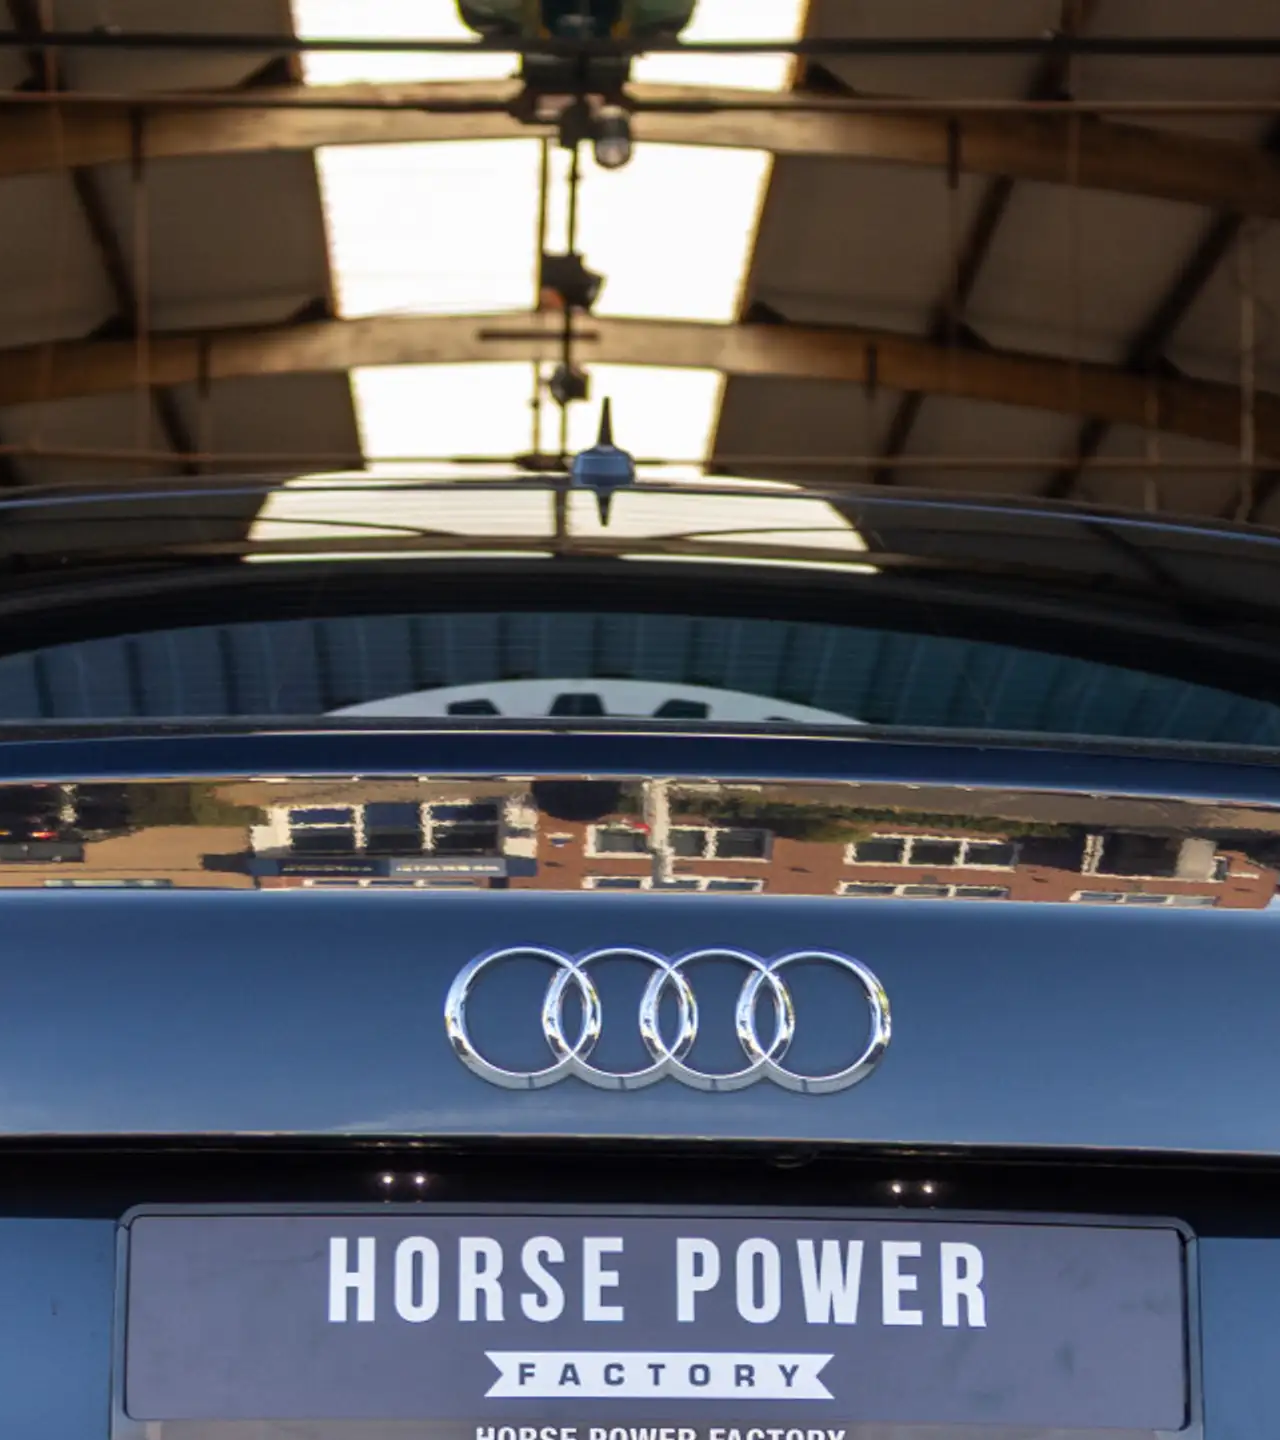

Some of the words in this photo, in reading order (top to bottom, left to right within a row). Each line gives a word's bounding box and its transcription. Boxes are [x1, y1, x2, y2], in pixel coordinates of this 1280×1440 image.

[327, 1235, 625, 1323] HORSE
[675, 1237, 988, 1328] POWER
[517, 1362, 801, 1389] FACTORY
